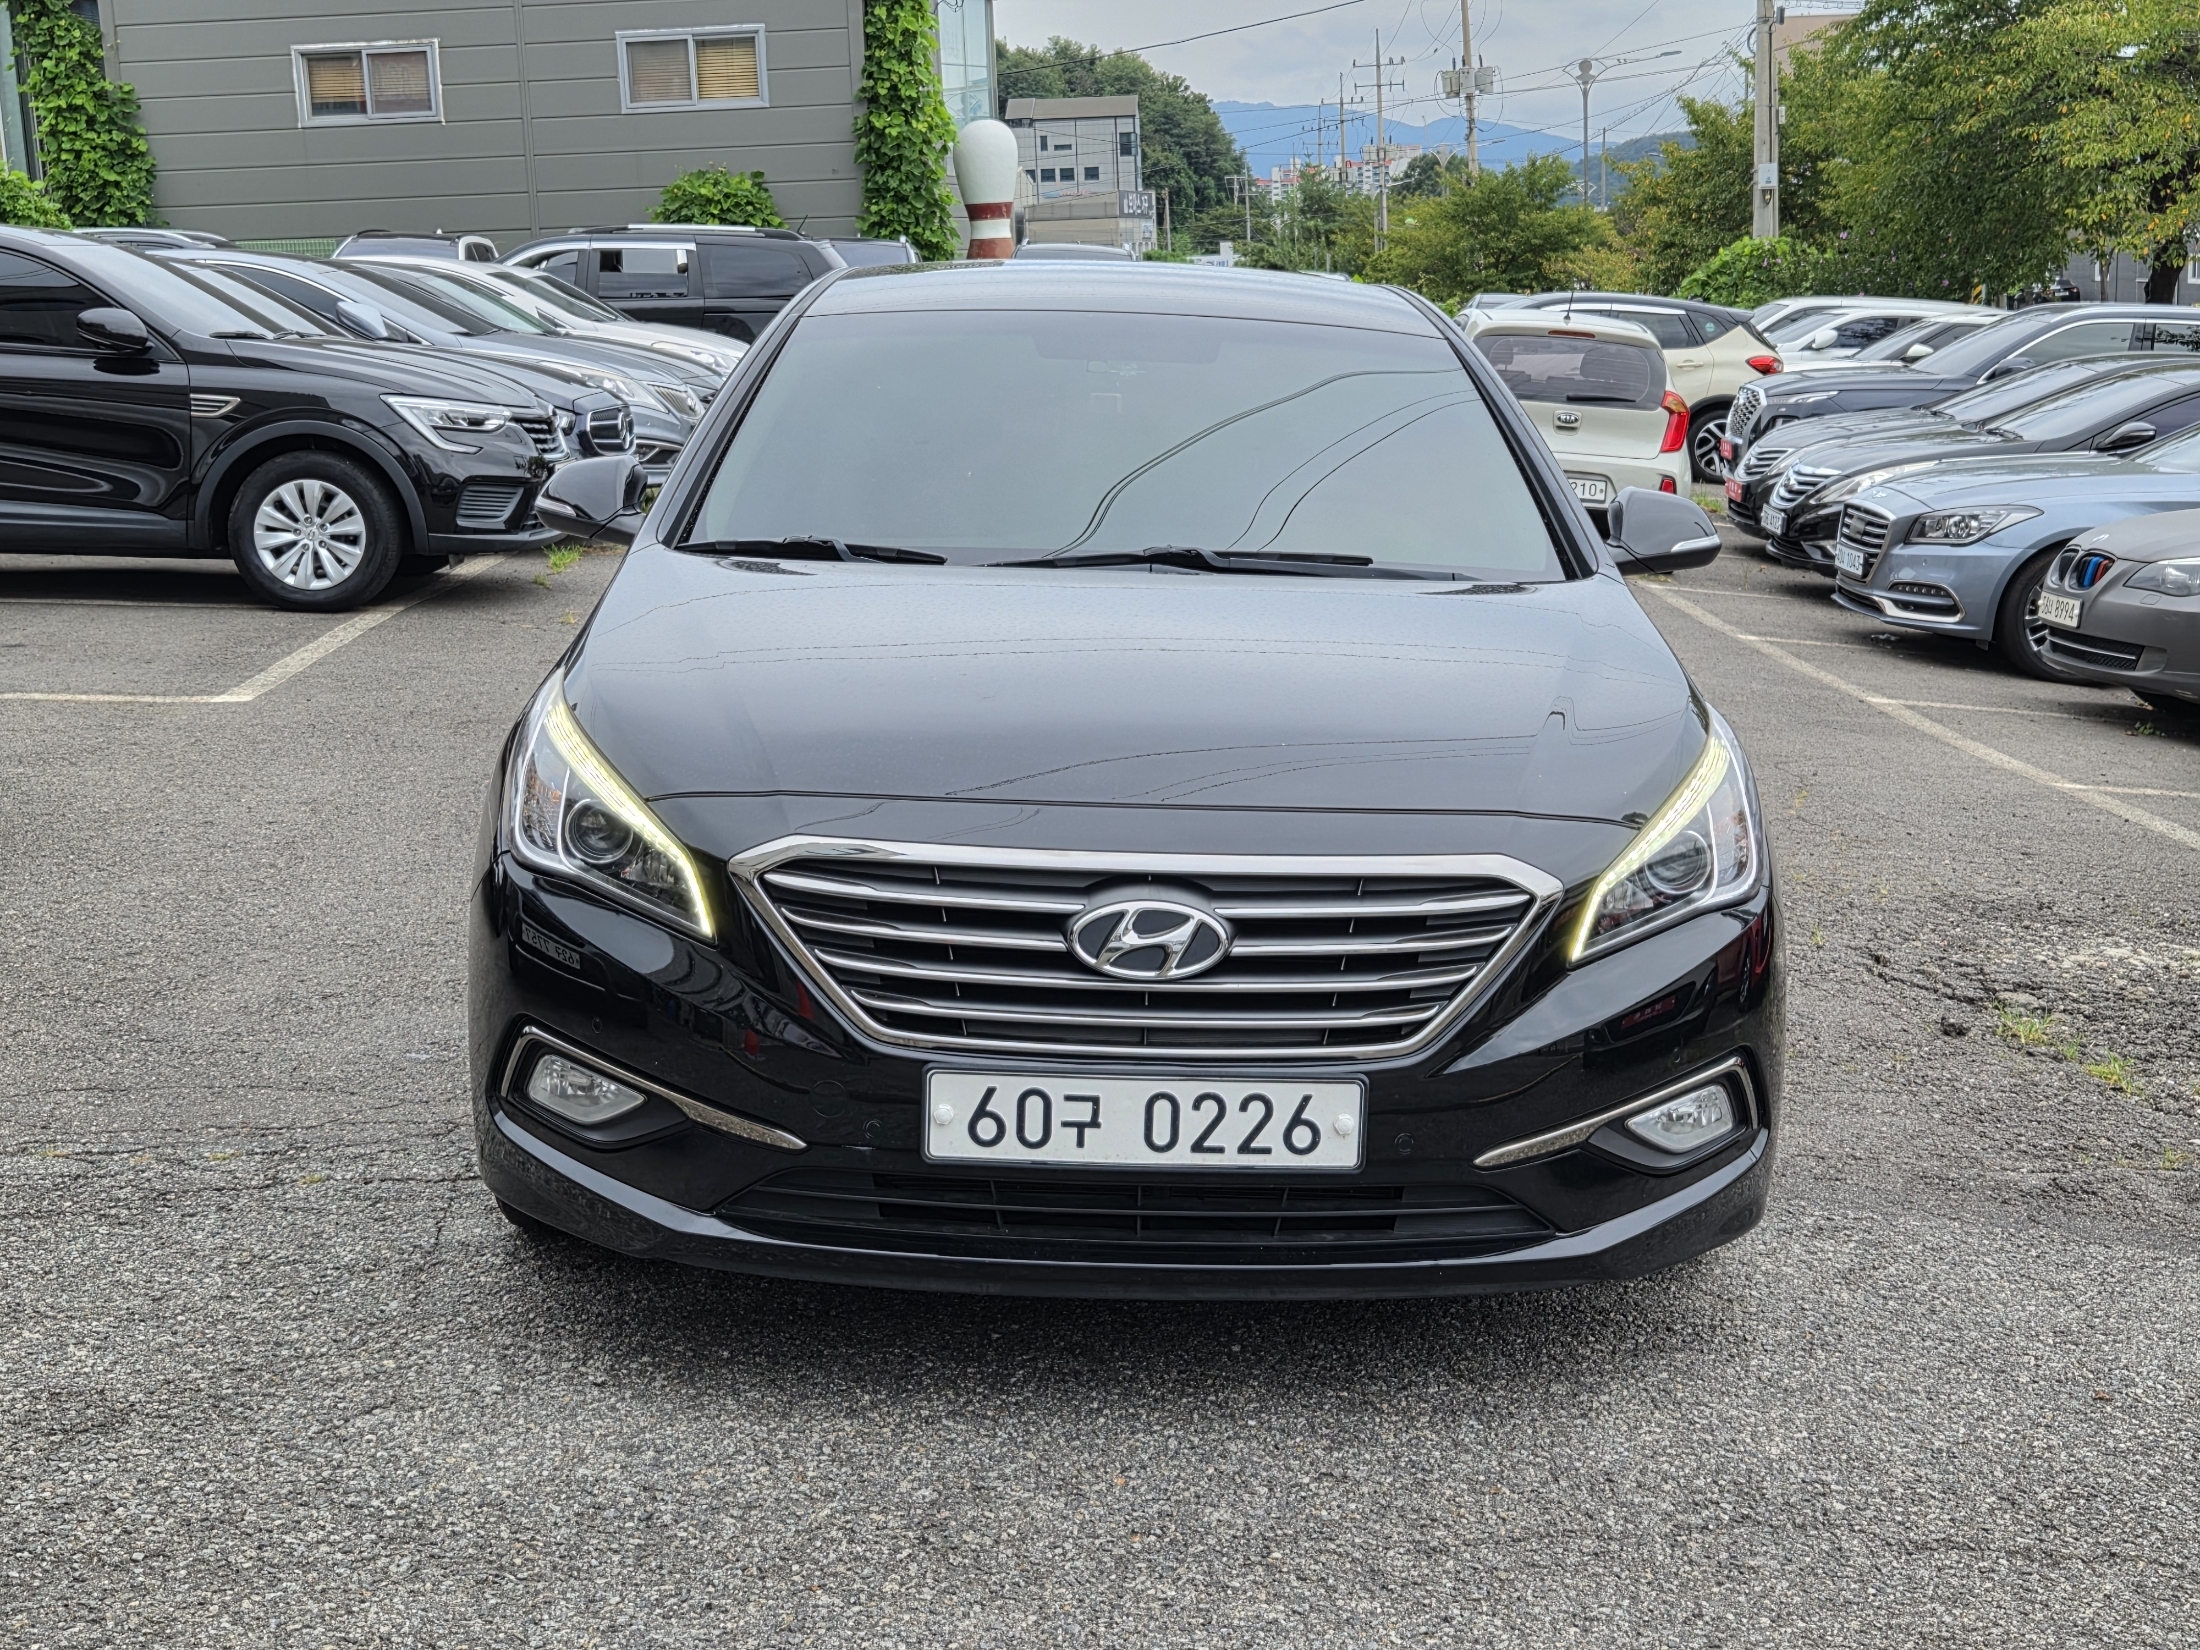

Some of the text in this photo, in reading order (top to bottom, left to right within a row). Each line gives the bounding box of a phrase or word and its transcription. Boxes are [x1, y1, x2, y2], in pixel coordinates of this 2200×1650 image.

[2055, 599, 2075, 622] 8994
[966, 1085, 1322, 1157] 60구 0226
